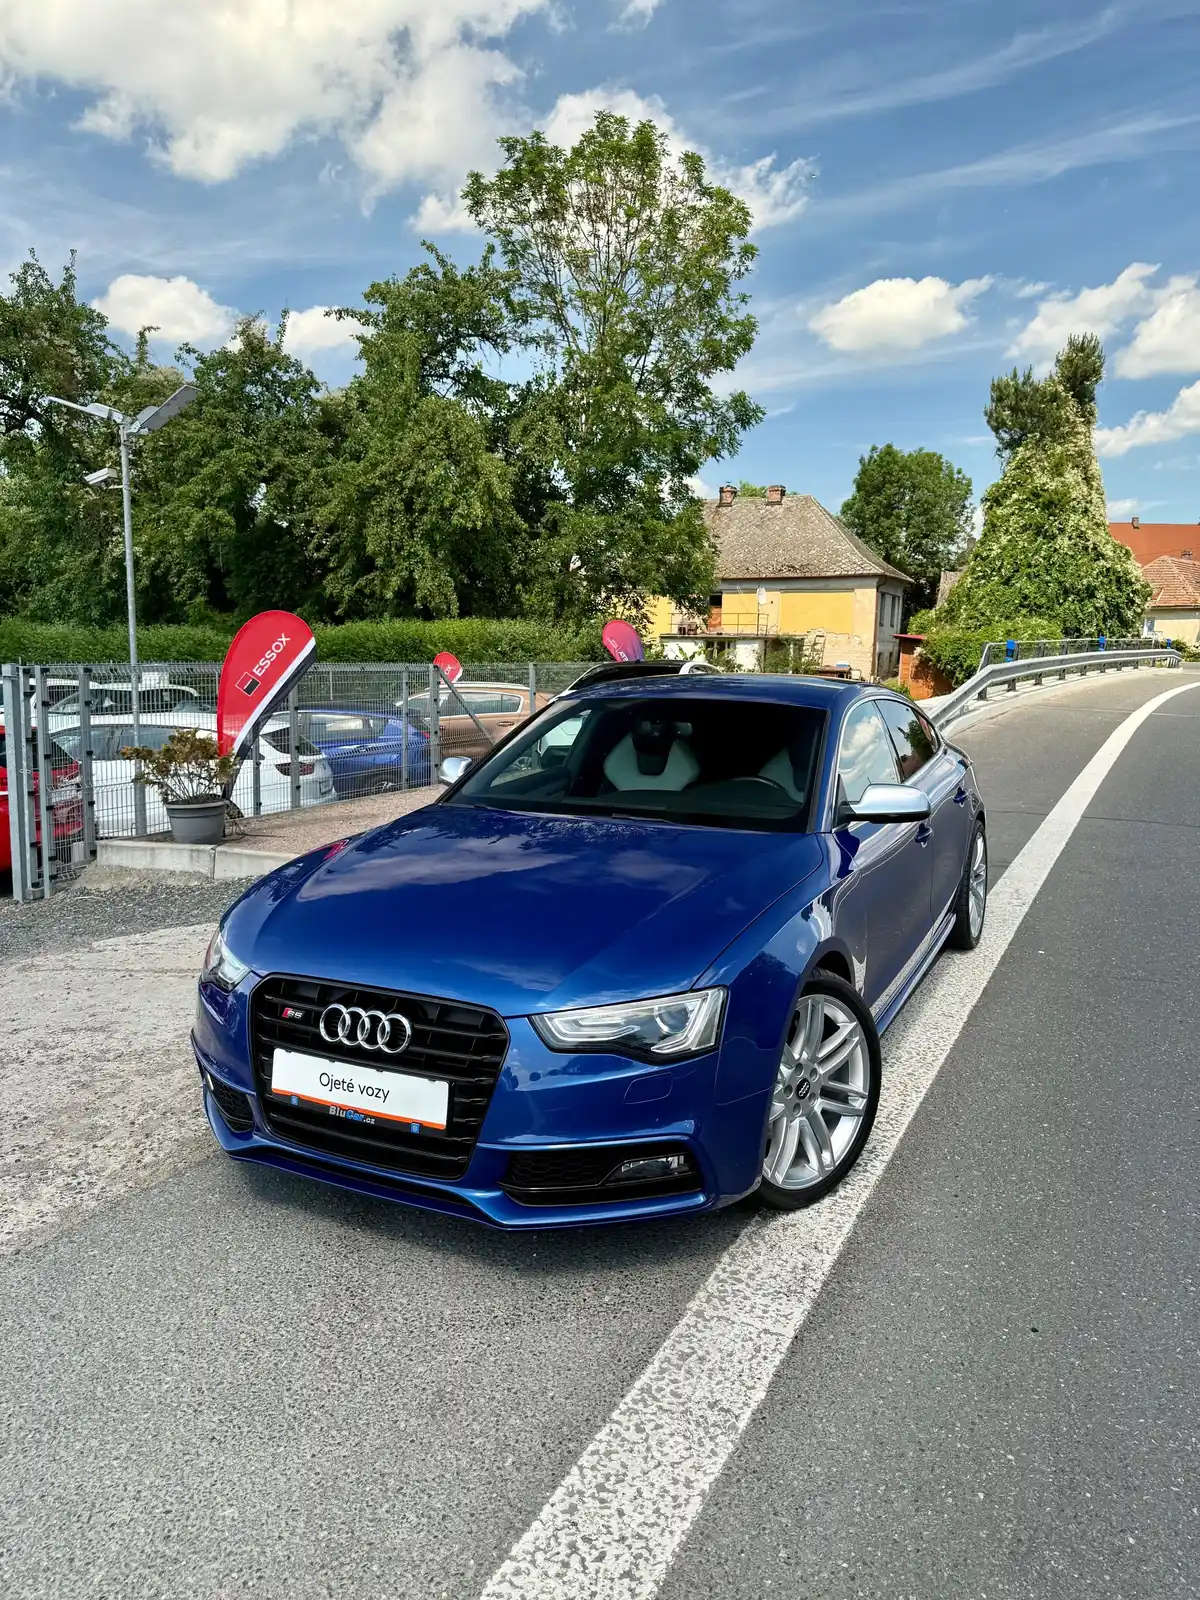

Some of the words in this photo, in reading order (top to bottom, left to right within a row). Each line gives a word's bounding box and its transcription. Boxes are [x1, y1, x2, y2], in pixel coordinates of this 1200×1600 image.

[252, 632, 291, 677] ESSOX
[319, 1072, 355, 1092] Ojeté
[358, 1084, 390, 1103] vozy
[328, 1105, 376, 1125] BluCar.cz
